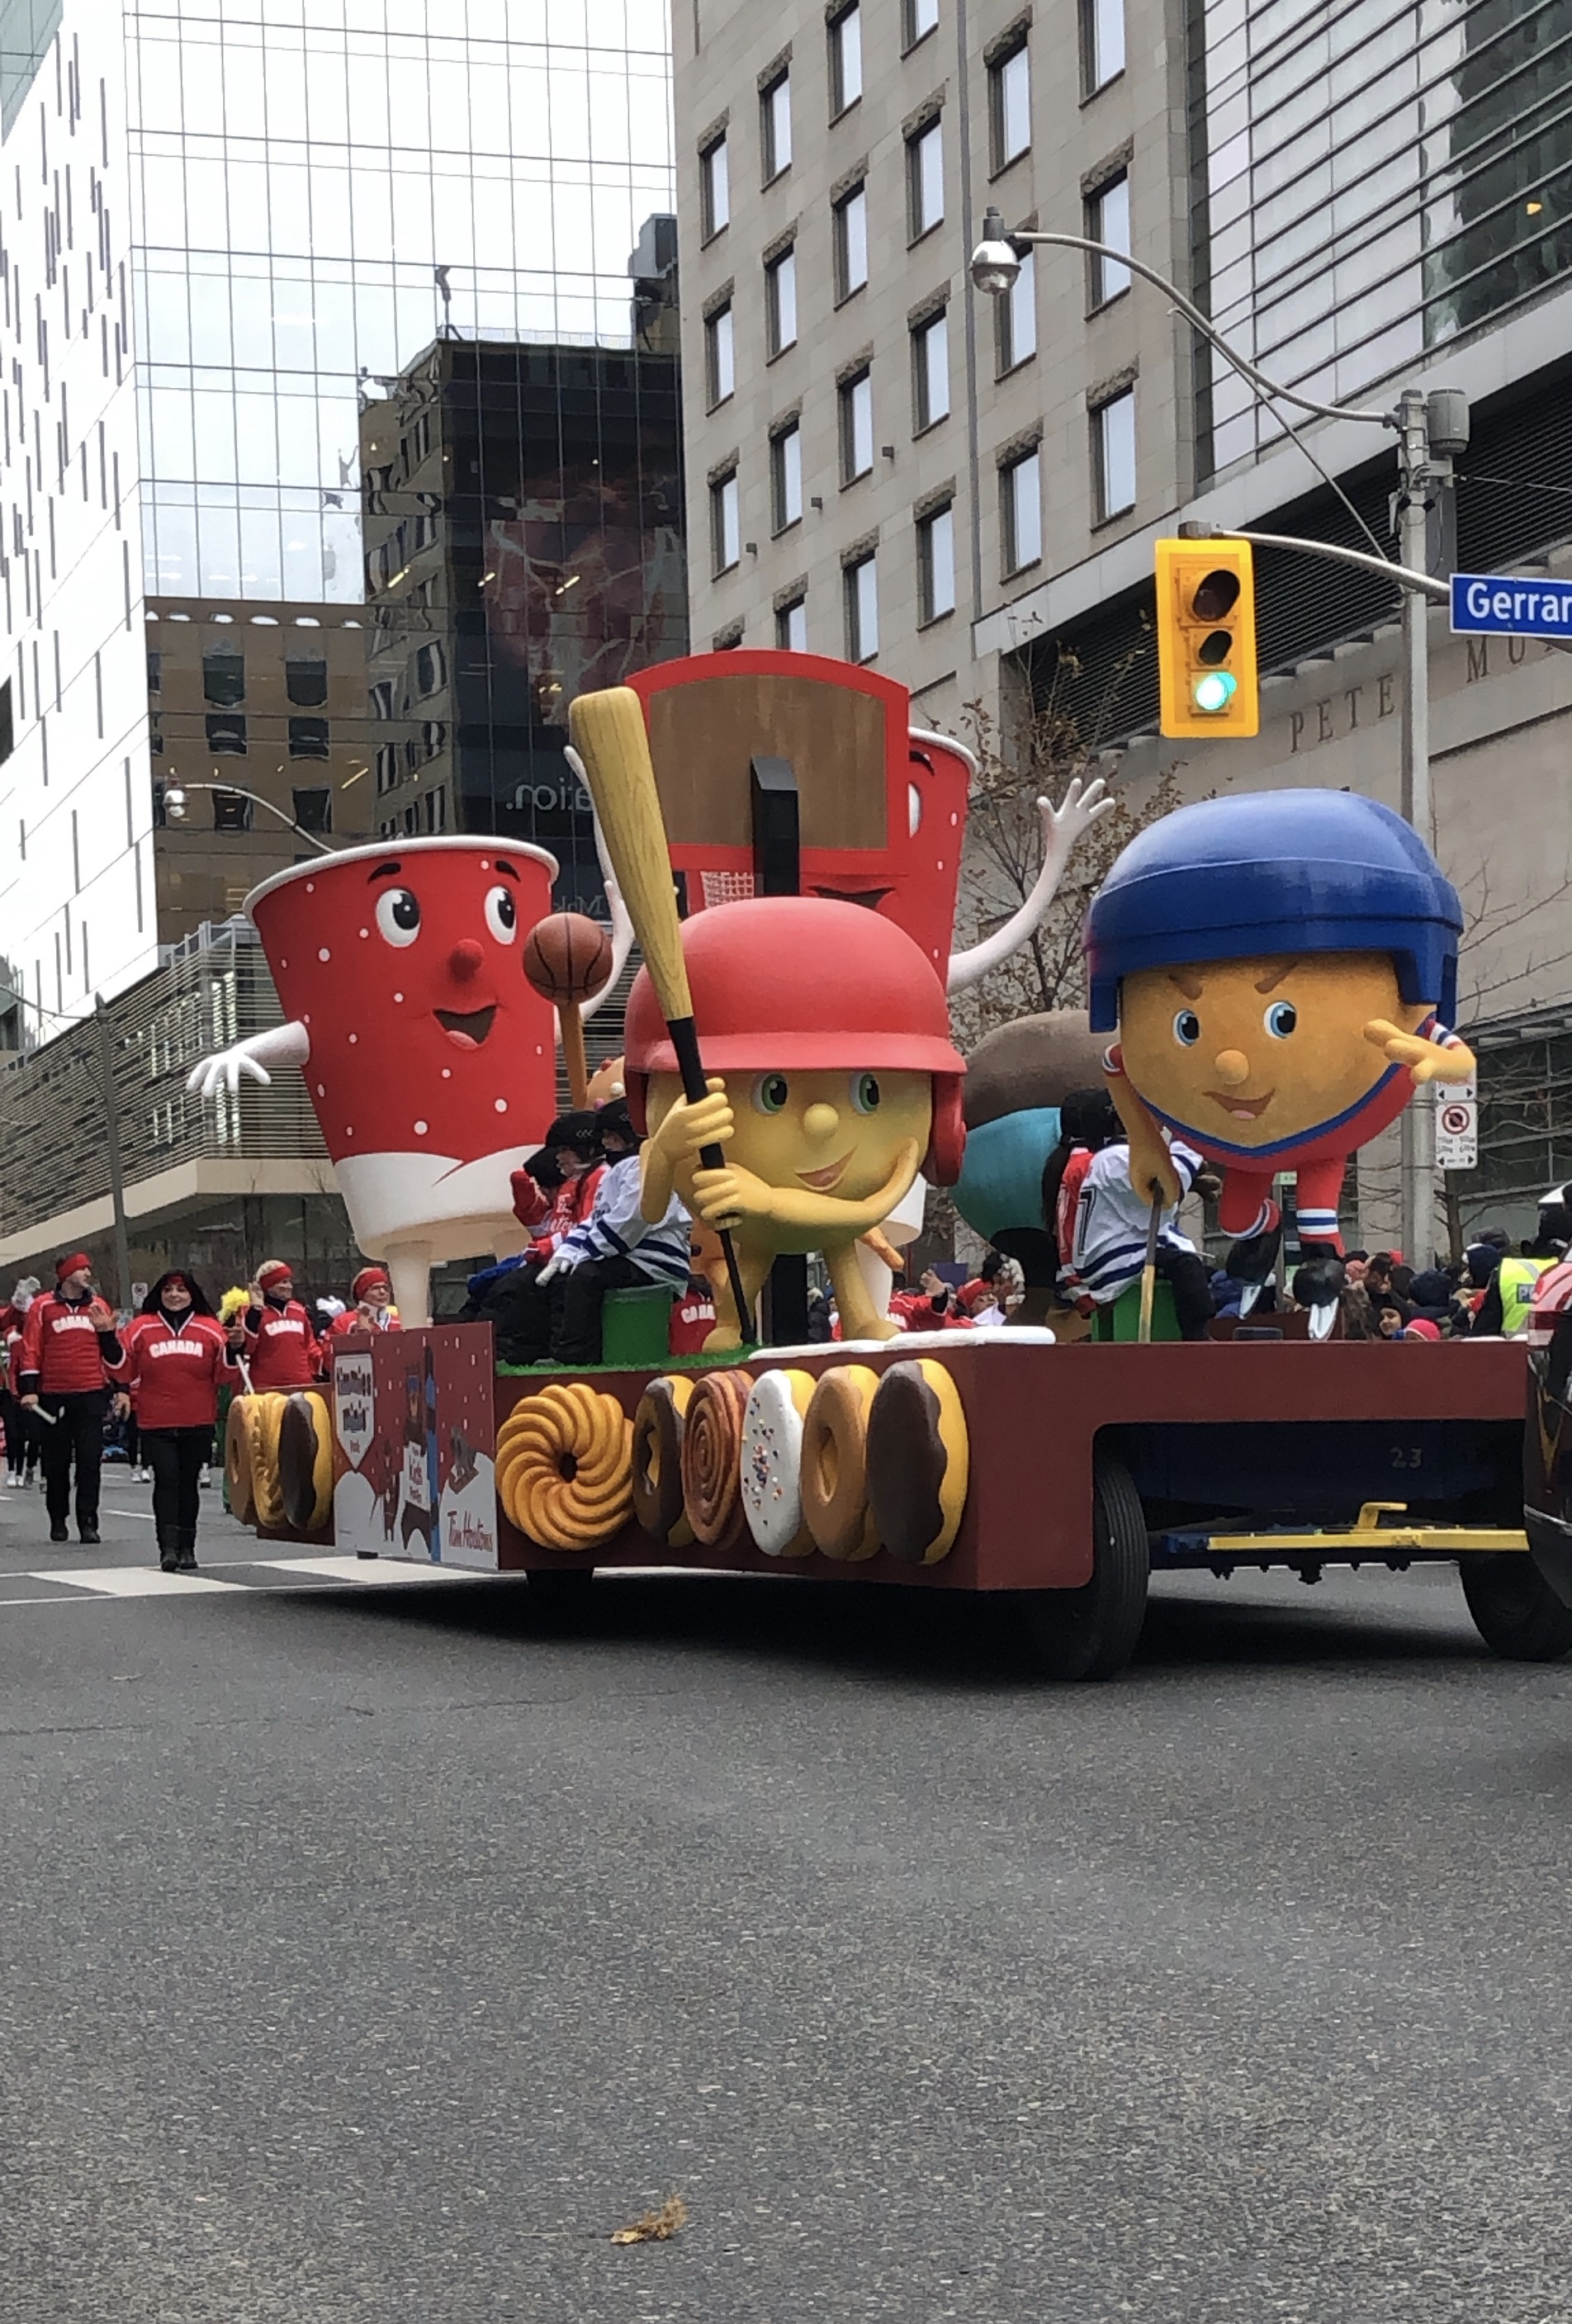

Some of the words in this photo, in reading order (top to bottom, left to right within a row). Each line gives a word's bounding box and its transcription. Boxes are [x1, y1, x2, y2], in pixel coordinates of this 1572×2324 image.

[1289, 672, 1395, 754] PETE
[149, 1339, 203, 1358] CANADA
[1390, 1446, 1423, 1468] 23
